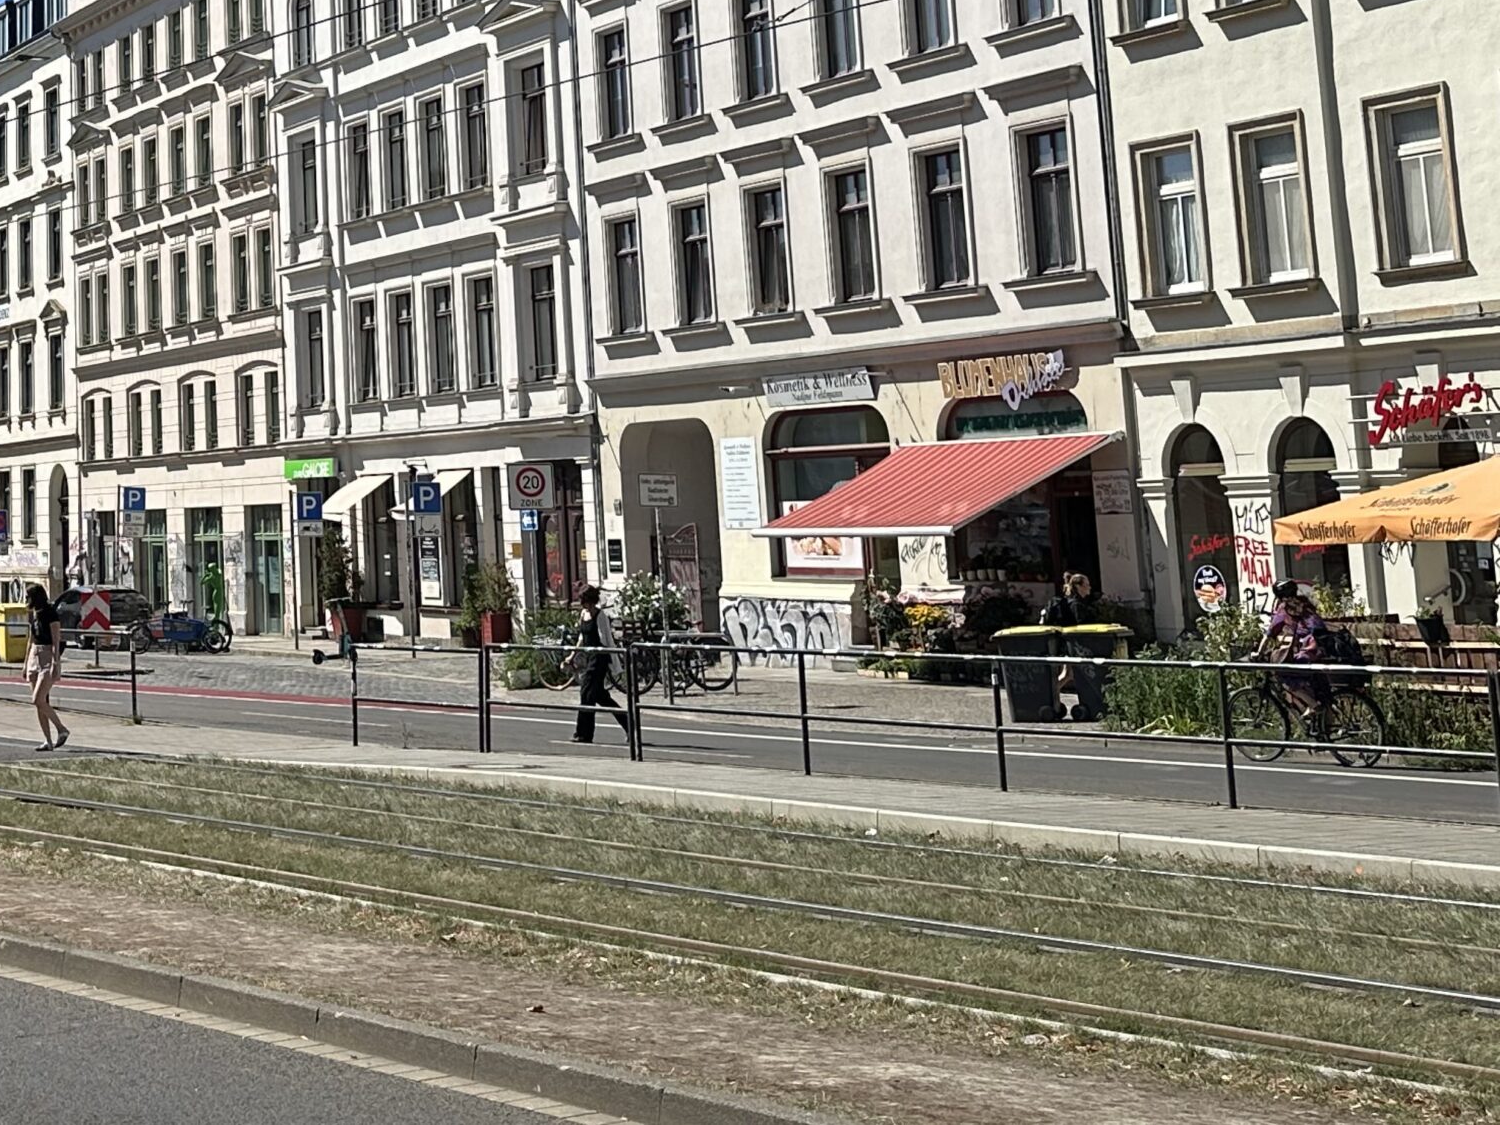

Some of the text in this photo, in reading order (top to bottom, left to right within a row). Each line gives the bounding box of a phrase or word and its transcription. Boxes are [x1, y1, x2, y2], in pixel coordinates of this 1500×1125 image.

[766, 372, 868, 395] Kosmetik & Wellness
[937, 352, 1048, 399] BLUMENHAUS
[522, 475, 540, 490] 20
[129, 490, 141, 508] P
[302, 496, 317, 518] P
[419, 486, 435, 510] P
[520, 499, 544, 507] ZONE
[1298, 520, 1357, 544] Schöfferhofer
[1411, 515, 1473, 539] Schöfferhofer
[1235, 535, 1272, 557] FREE
[1240, 556, 1274, 588] MAJA
